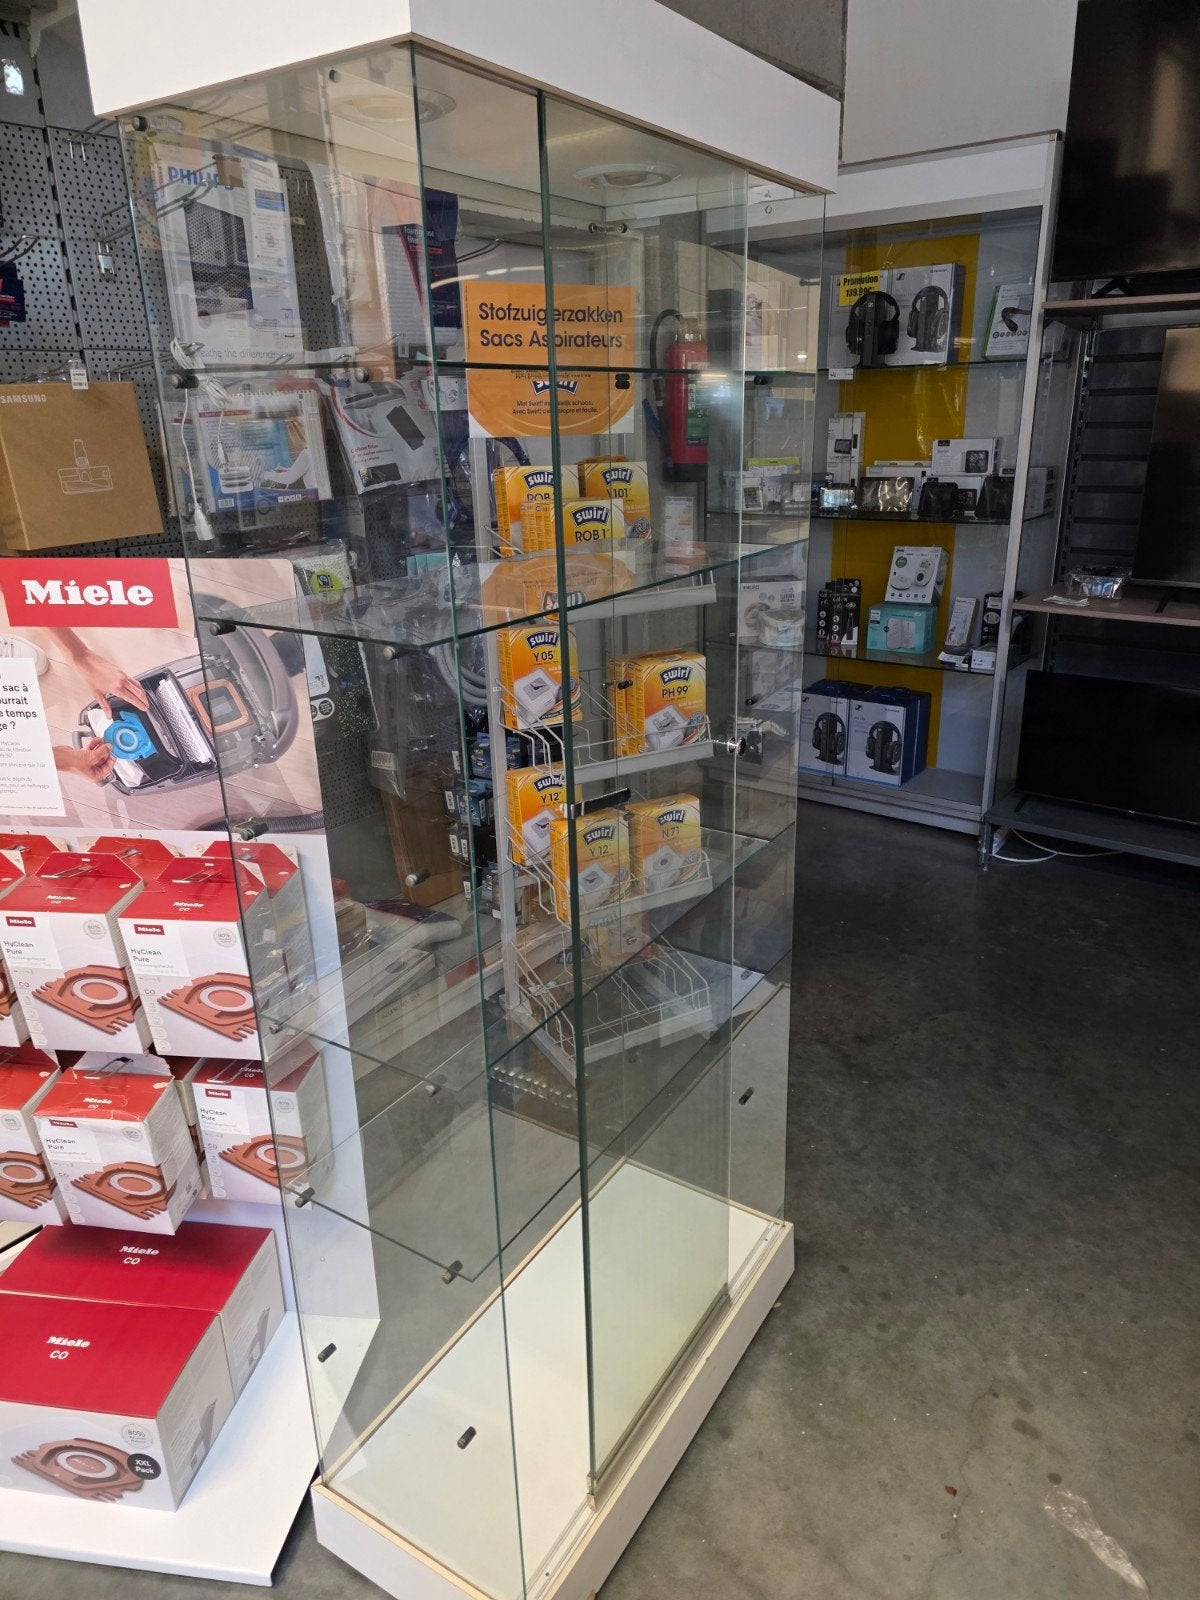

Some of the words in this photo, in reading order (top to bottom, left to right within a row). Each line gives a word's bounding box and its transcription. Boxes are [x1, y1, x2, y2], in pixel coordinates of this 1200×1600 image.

[843, 275, 878, 286] Promotion
[480, 329, 523, 347] Sacs
[0, 394, 47, 404] SAMSUNG
[528, 471, 554, 485] swir
[605, 468, 631, 481] swirl
[575, 507, 608, 523] swirl
[575, 530, 599, 543] ROB
[21, 579, 154, 606] Miele
[530, 632, 557, 646] swirl
[533, 653, 540, 661] Y
[541, 651, 554, 661] 05
[663, 667, 690, 681] swirl
[22, 683, 29, 692] à
[662, 688, 675, 699] PH
[676, 686, 689, 695] 99
[0, 697, 28, 705] urrait
[6, 709, 38, 719] temps
[10, 721, 16, 730] ?
[540, 795, 547, 803] Y
[549, 792, 559, 802] 12
[586, 826, 613, 842] swirl
[589, 849, 596, 857] Y
[599, 845, 609, 855] 12
[130, 948, 162, 956] HyClean
[200, 1108, 228, 1116] HyClean
[119, 1245, 160, 1255] Miele
[123, 1257, 141, 1265] CO
[46, 1336, 91, 1348] Miele
[50, 1350, 69, 1360] CO
[128, 1429, 146, 1438] 80%
[135, 1466, 155, 1474] Pack
